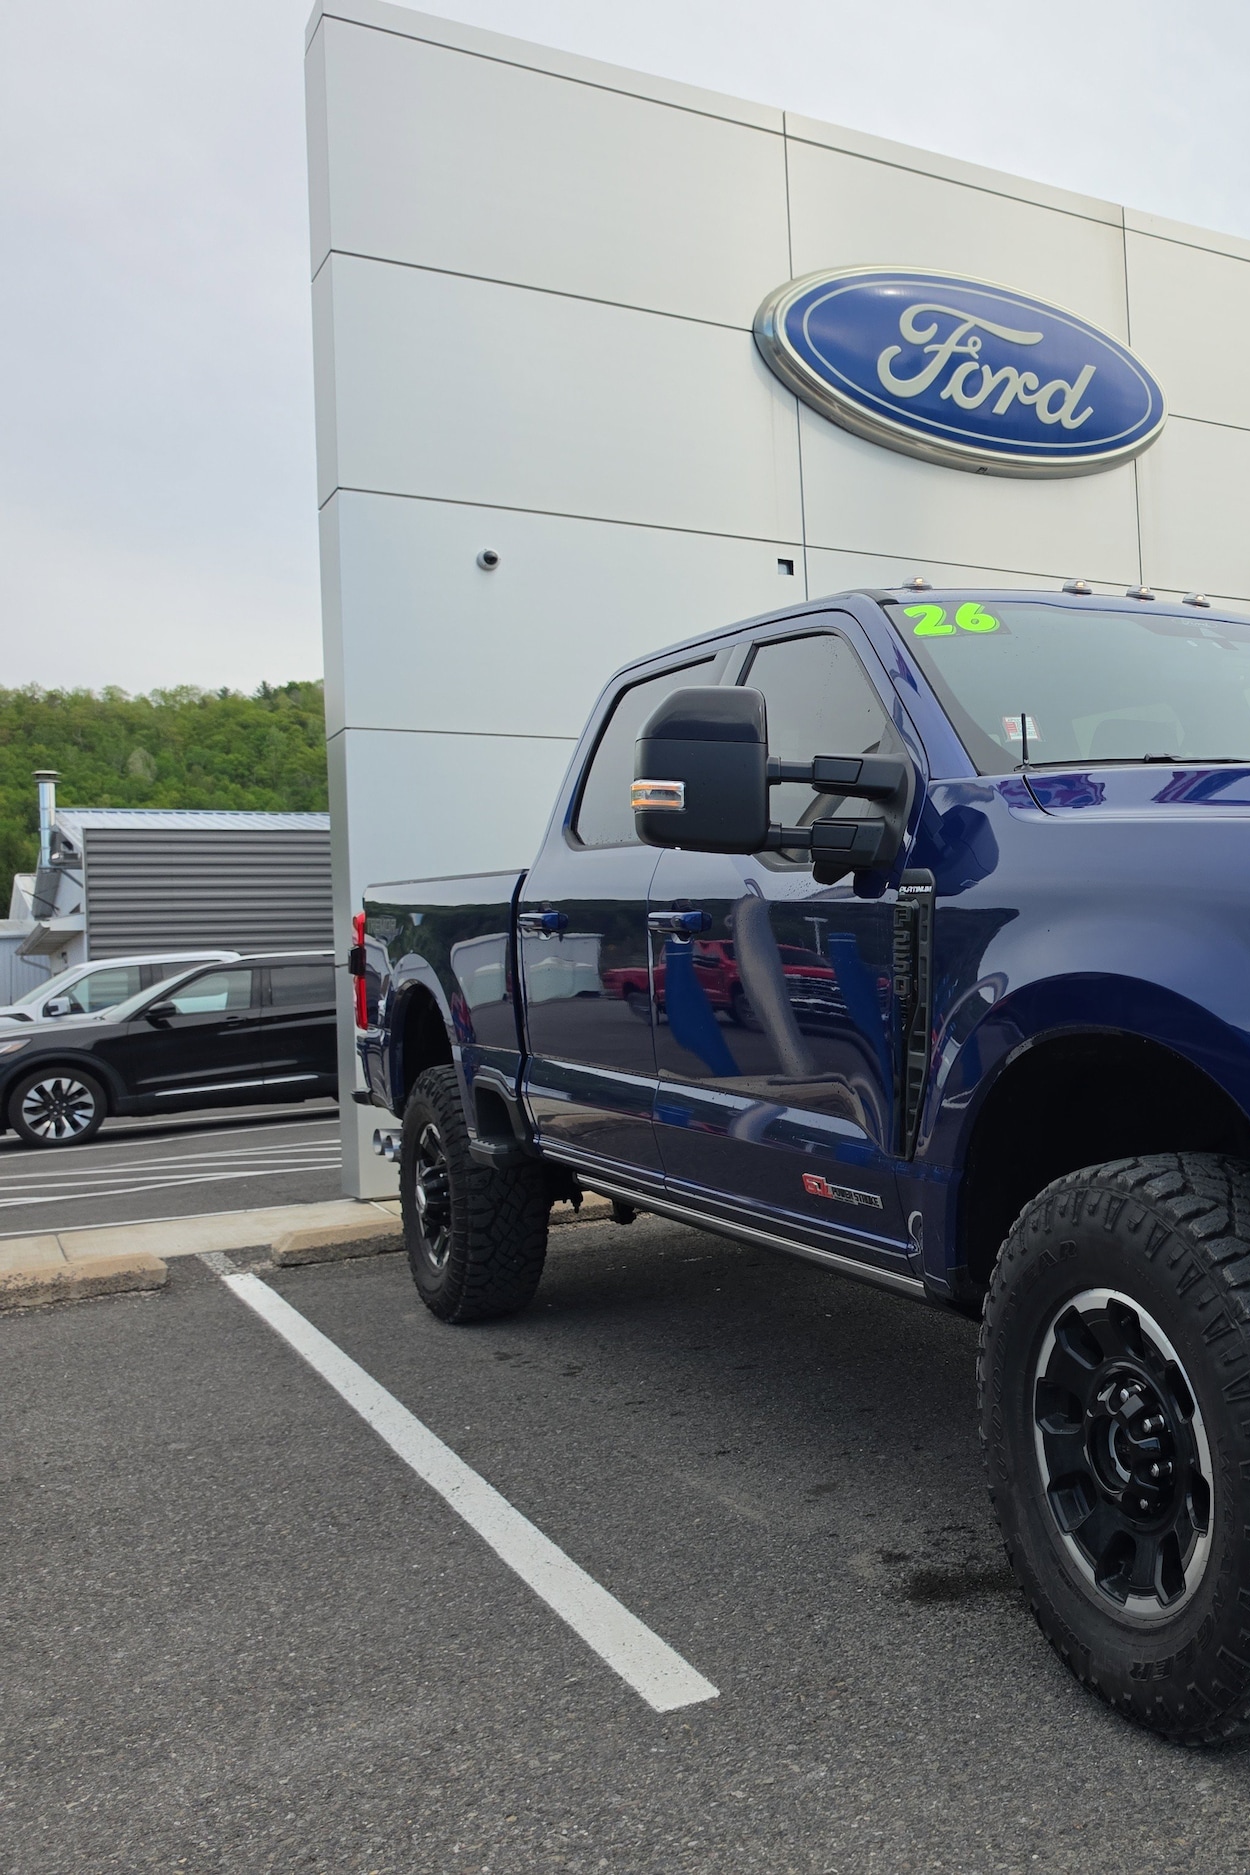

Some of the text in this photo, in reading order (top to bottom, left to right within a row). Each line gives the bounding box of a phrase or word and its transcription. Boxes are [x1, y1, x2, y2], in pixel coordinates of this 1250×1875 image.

[877, 303, 1095, 431] Ford
[903, 602, 1001, 637] 26
[899, 884, 933, 894] PLATINUM
